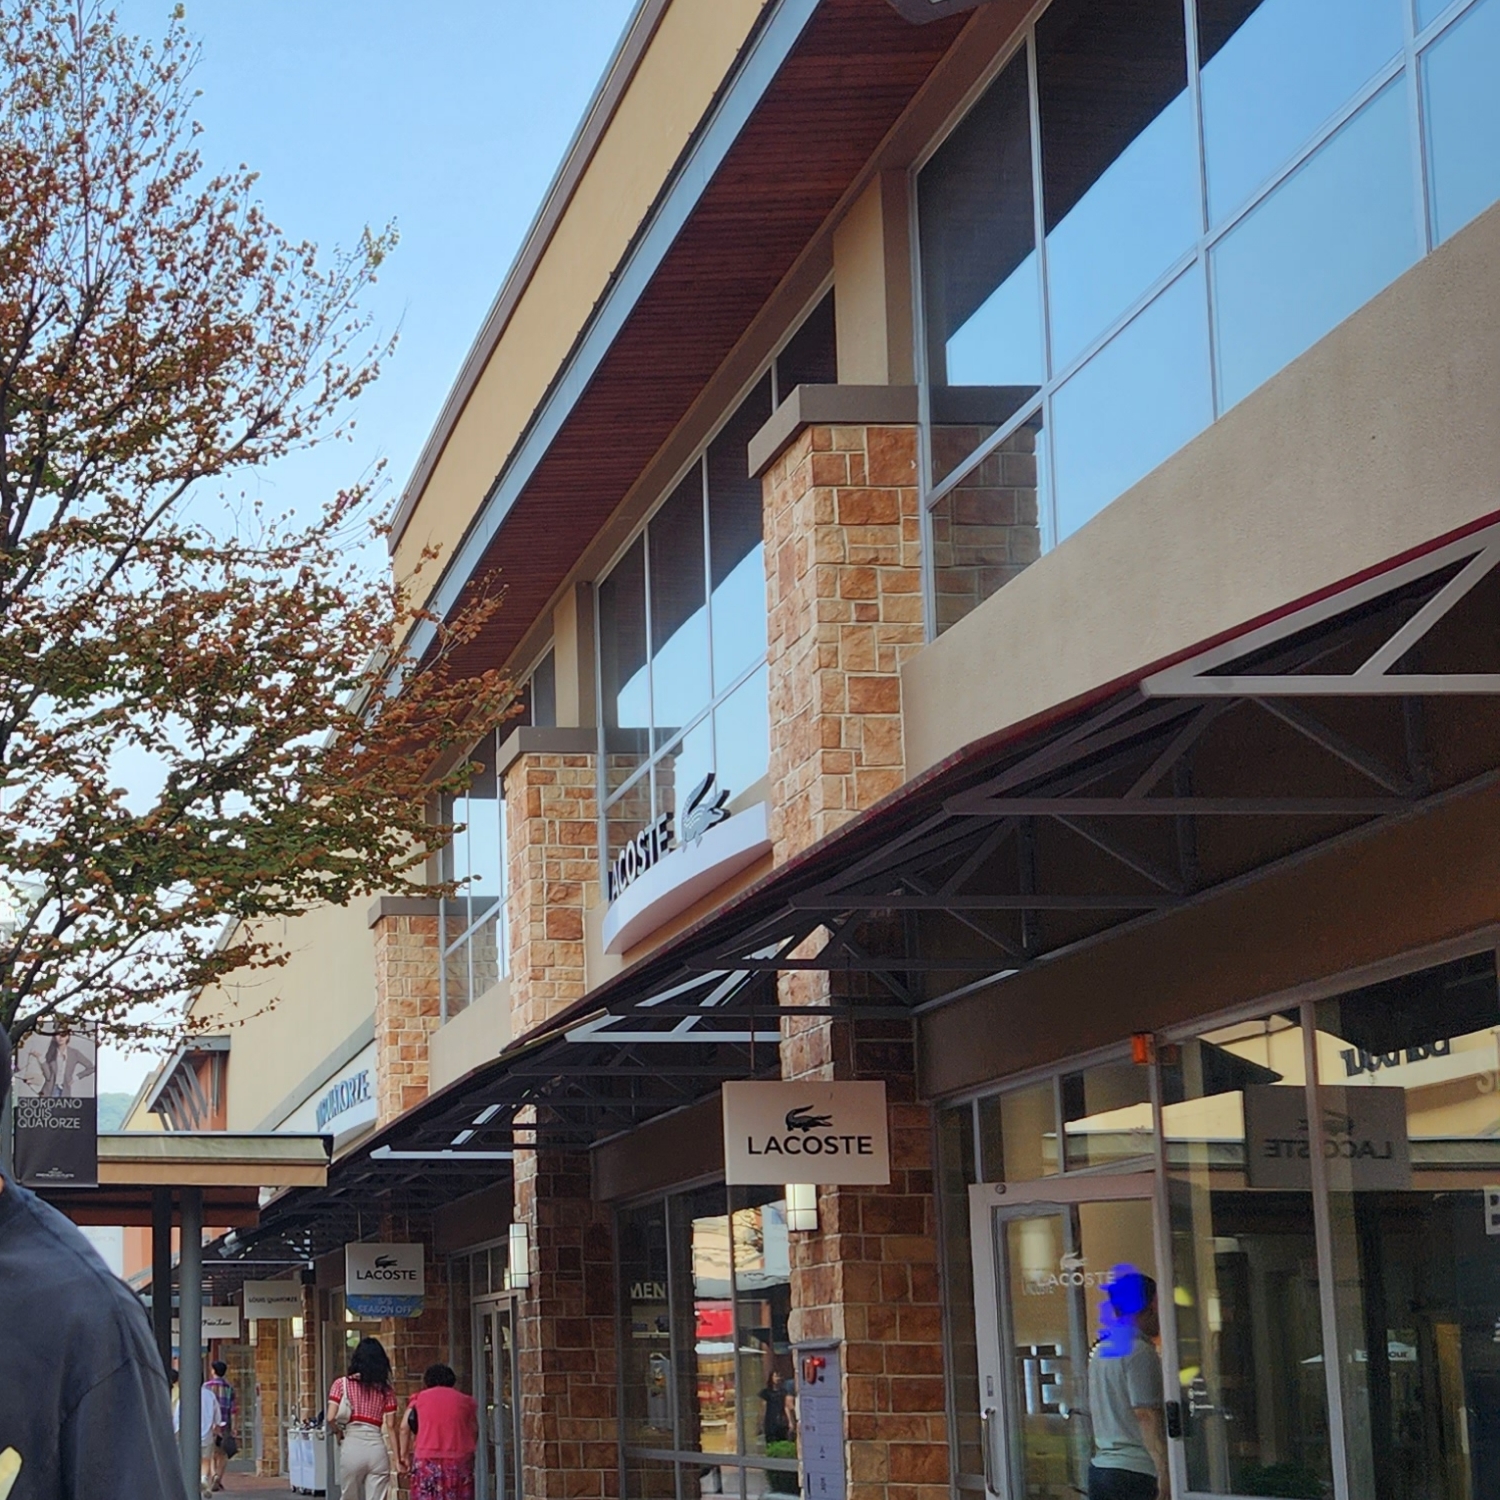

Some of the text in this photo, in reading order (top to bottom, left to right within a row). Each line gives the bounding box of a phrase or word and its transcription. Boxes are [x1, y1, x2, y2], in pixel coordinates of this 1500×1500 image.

[19, 1098, 82, 1109] GIORDANO
[18, 1108, 52, 1118] LOUIS
[17, 1117, 81, 1129] QUATORZE
[747, 1136, 874, 1155] LACOSTE
[356, 1269, 417, 1280] LACOSTE
